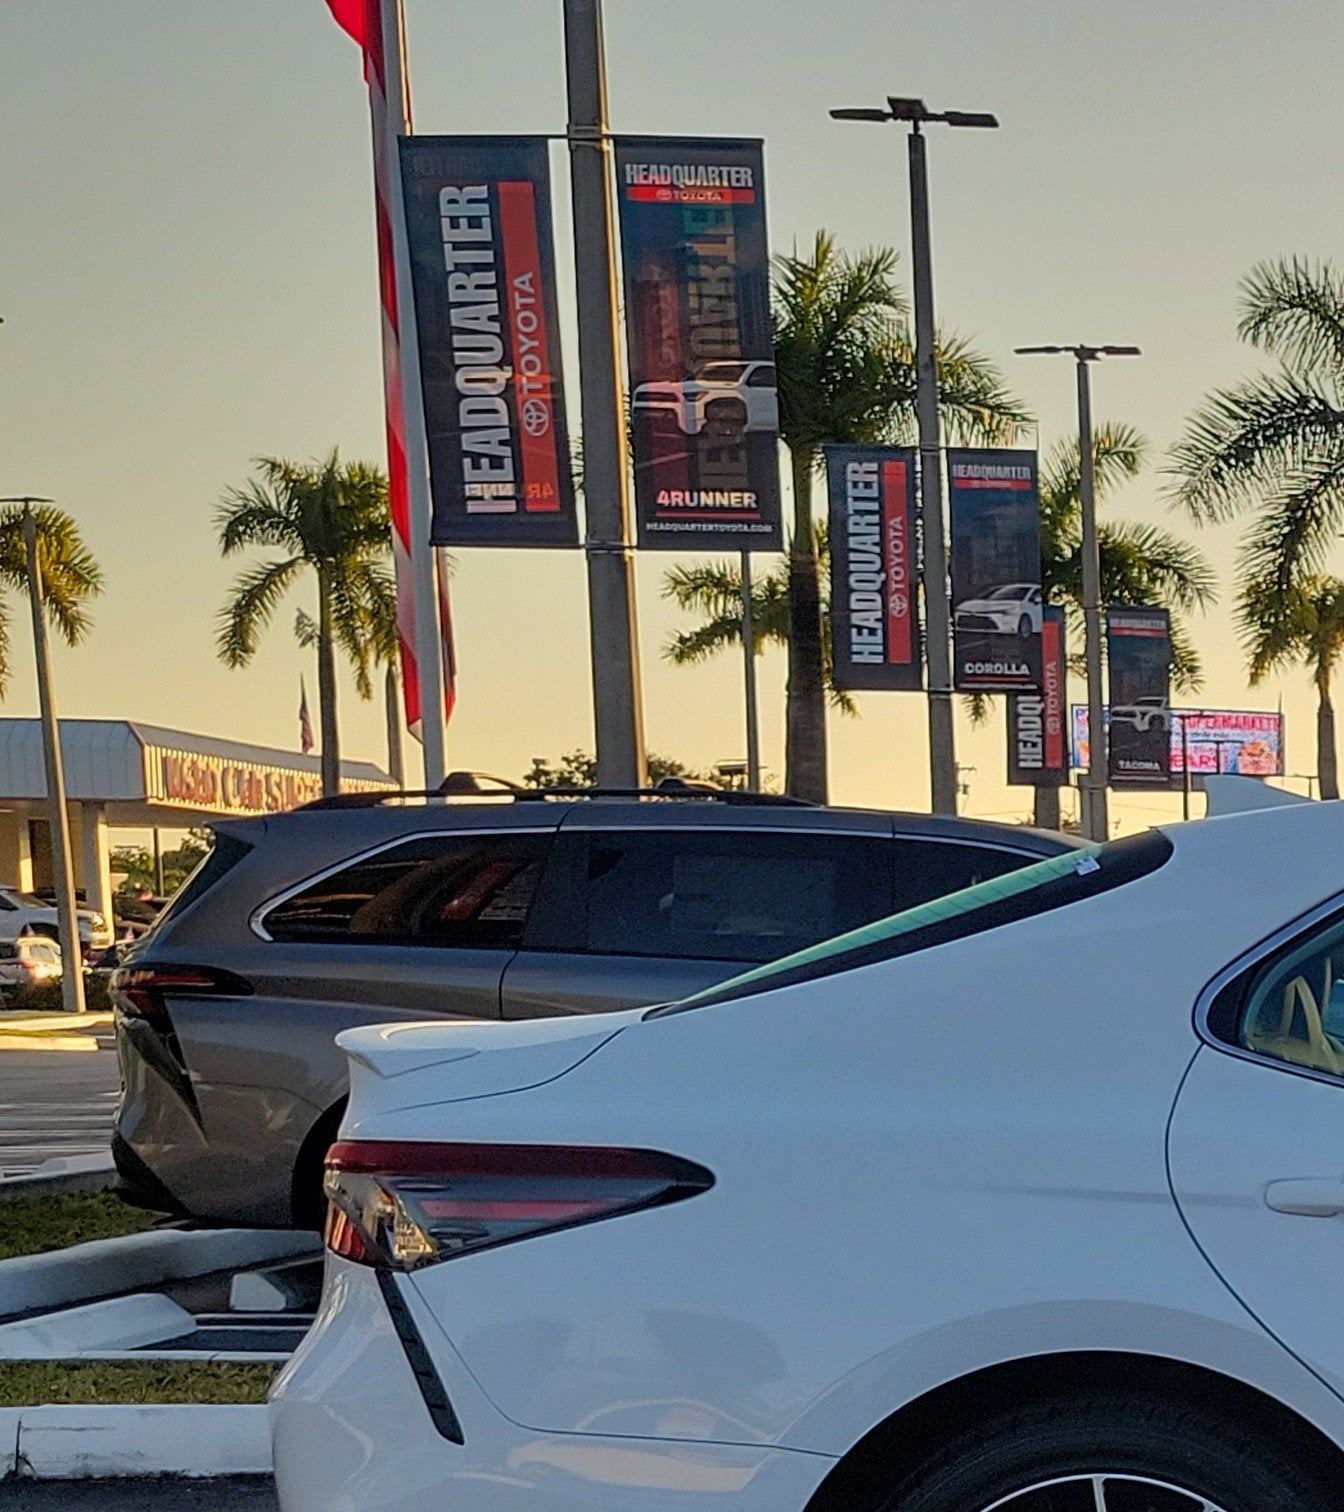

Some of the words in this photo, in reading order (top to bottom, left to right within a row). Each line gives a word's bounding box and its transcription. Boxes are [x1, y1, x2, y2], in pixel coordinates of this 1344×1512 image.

[625, 164, 753, 188] HEADQUARTER
[673, 190, 722, 201] TOYOTA
[439, 184, 517, 514] HEADQUARTER
[512, 271, 542, 396] TOYOTA
[952, 464, 1032, 481] HEADQUARTER
[656, 490, 757, 508] 4RUNNER
[847, 461, 884, 664] HEADQUARTER
[889, 516, 906, 590] TOYOTA
[964, 661, 1030, 675] COROLLA
[1047, 660, 1060, 715] TOYOTA
